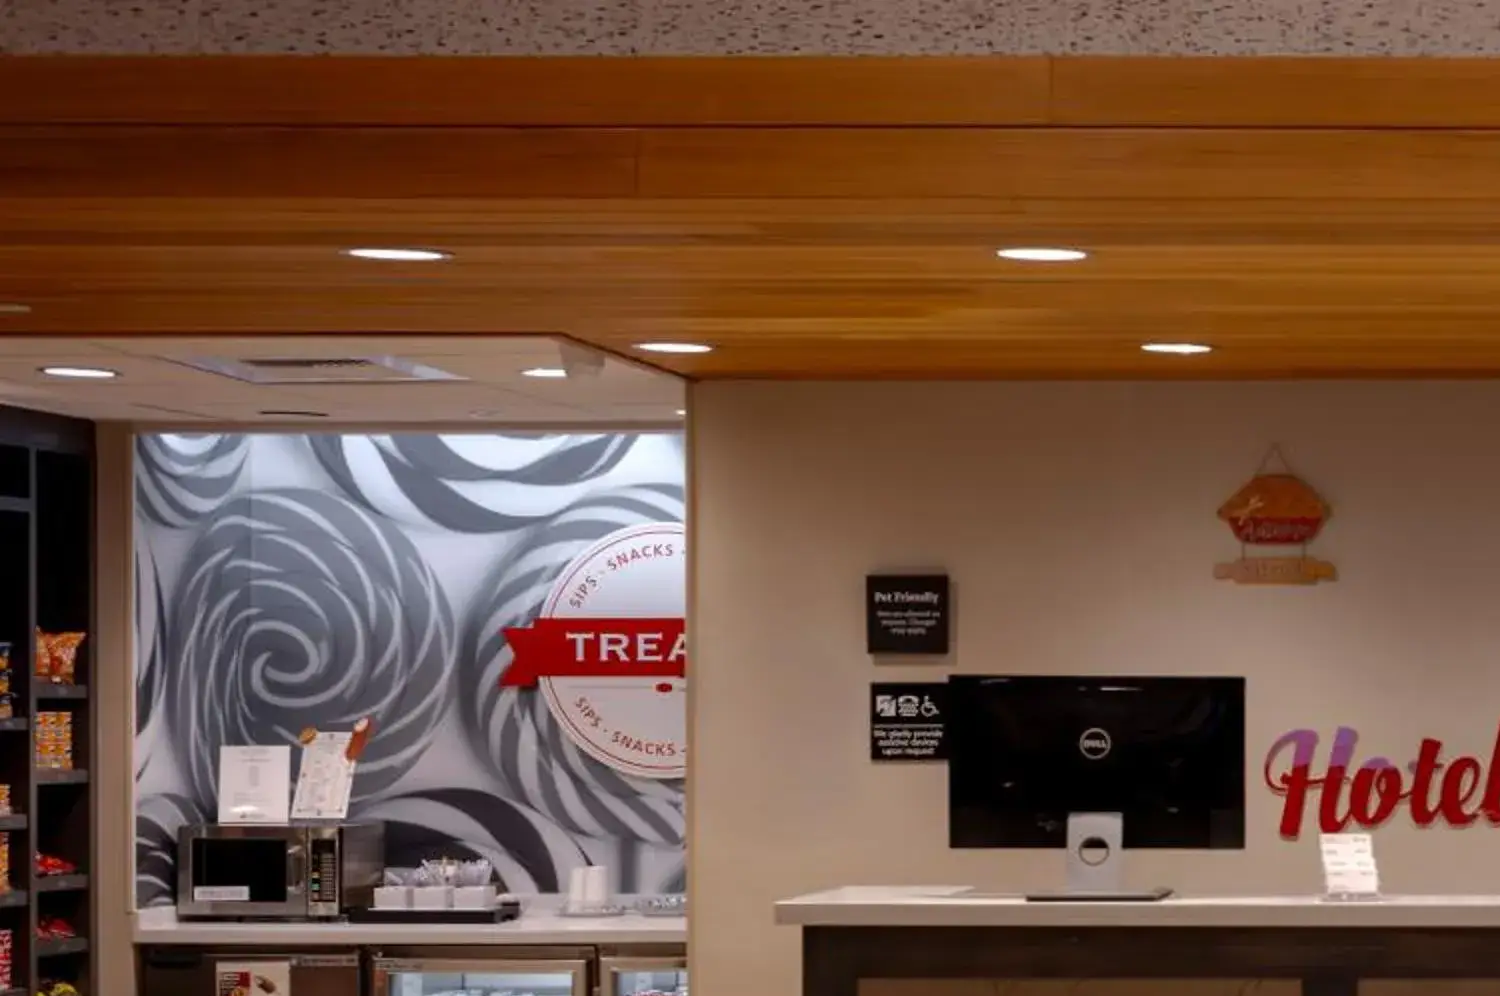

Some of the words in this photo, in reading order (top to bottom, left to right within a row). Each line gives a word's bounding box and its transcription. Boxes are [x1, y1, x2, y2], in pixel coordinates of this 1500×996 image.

[569, 576, 597, 609] SIPS
[608, 544, 674, 570] SNACKS
[874, 591, 893, 604] Pet
[575, 696, 603, 728] SIPS
[611, 730, 677, 757] SNACKS
